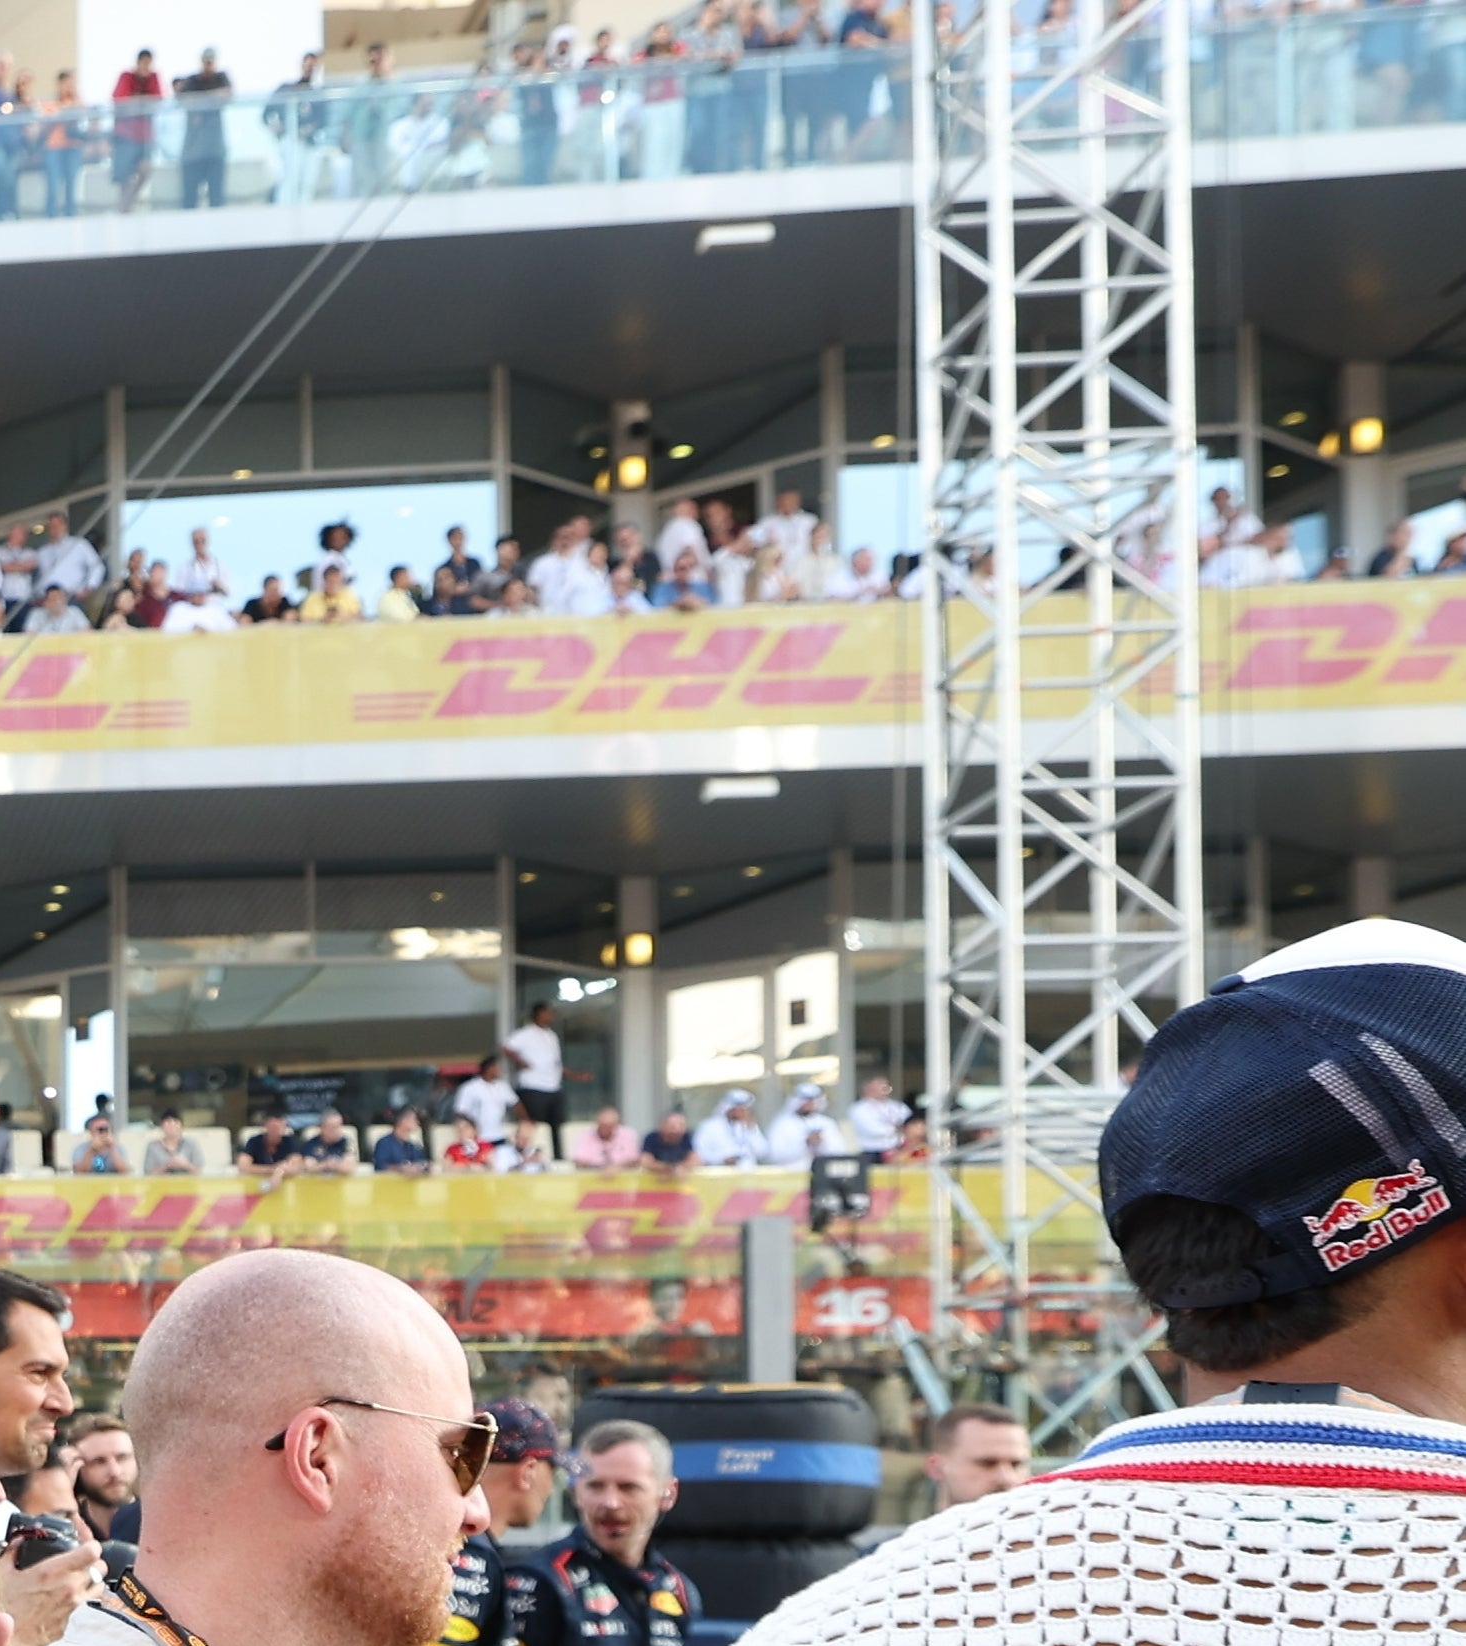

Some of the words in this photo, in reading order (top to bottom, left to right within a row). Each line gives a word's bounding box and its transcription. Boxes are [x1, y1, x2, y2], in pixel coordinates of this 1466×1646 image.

[434, 622, 870, 718] DHL
[1318, 1219, 1393, 1272] Red
[1382, 1185, 1451, 1240] Bull
[814, 1287, 891, 1328] 16
